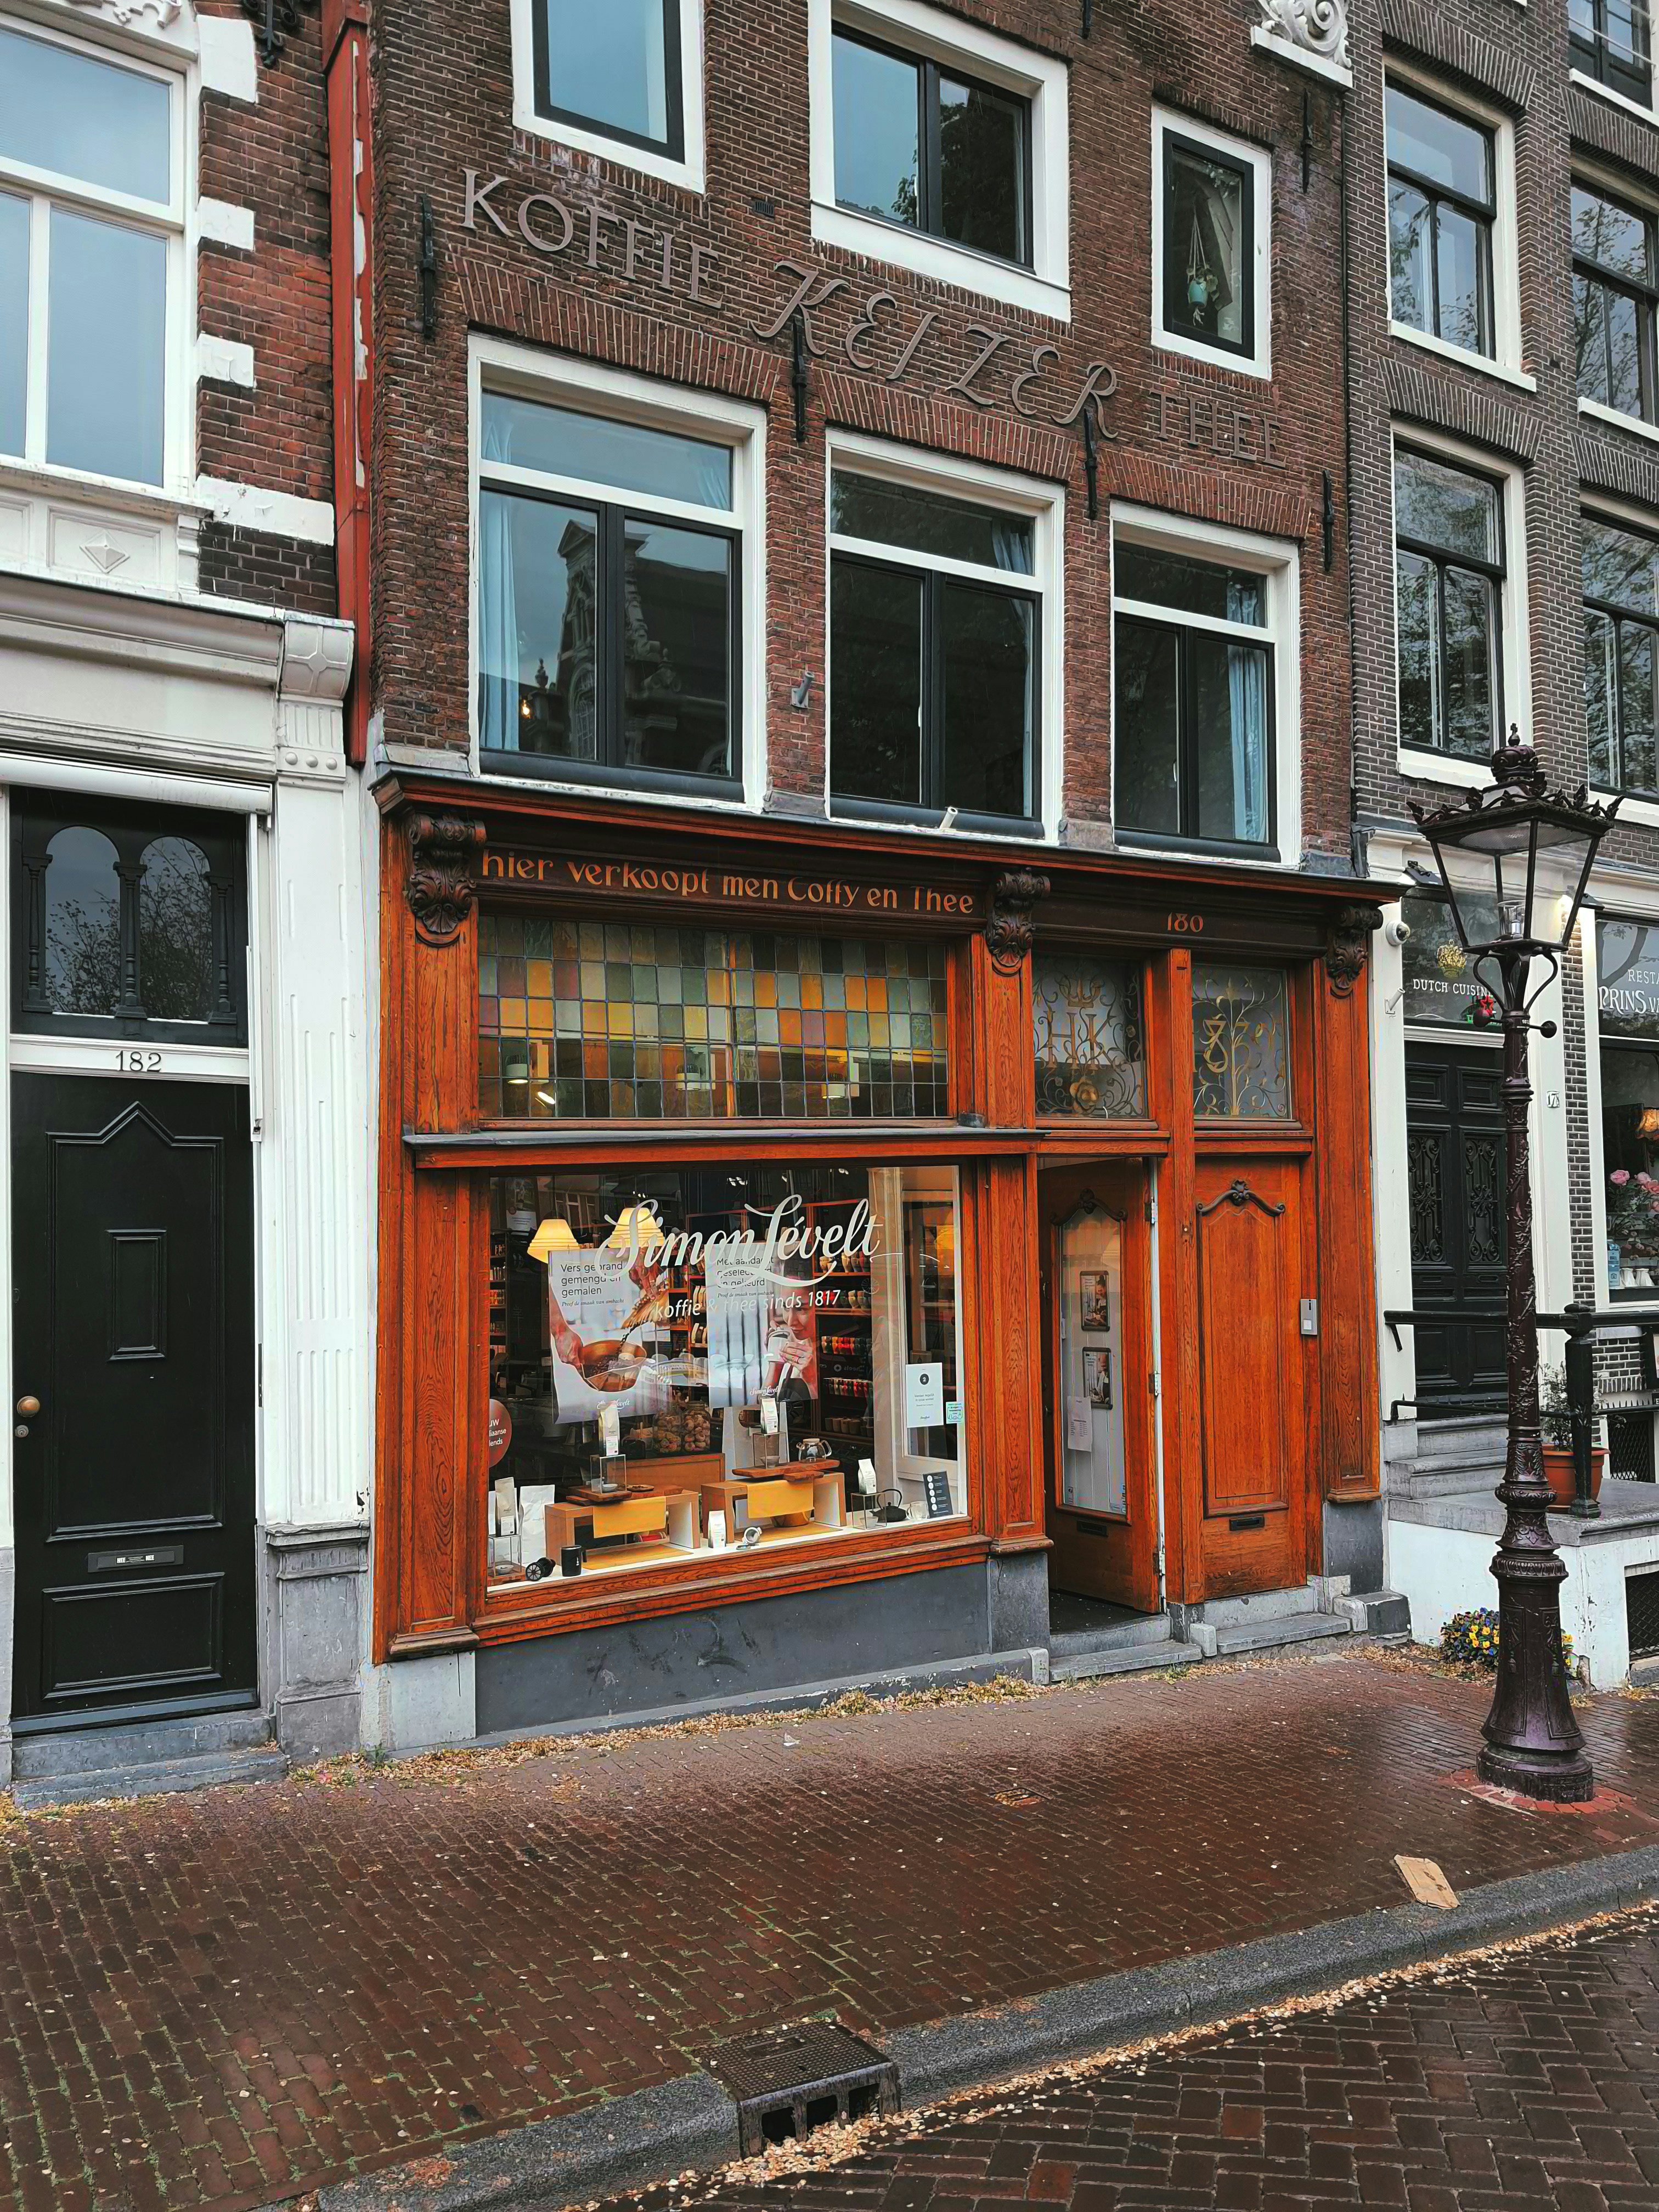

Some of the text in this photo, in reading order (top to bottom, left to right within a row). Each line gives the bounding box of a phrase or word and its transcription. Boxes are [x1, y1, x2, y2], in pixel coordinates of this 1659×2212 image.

[459, 168, 1286, 469] KOFFIE KEIZER THEE
[482, 849, 973, 914] hier verkoopt men Coffy en Thee
[1167, 912, 1203, 933] 180
[1413, 979, 1448, 993] DUTCH
[1598, 986, 1647, 1015] PRINS
[116, 1050, 161, 1072] 182
[594, 1194, 884, 1288] Simon Lévelt
[561, 1263, 581, 1273] Vers
[561, 1286, 602, 1299] gemalen
[656, 1298, 701, 1319] koffie
[724, 1296, 757, 1313] thee
[763, 1291, 802, 1310] sinds
[808, 1289, 841, 1307] 1817
